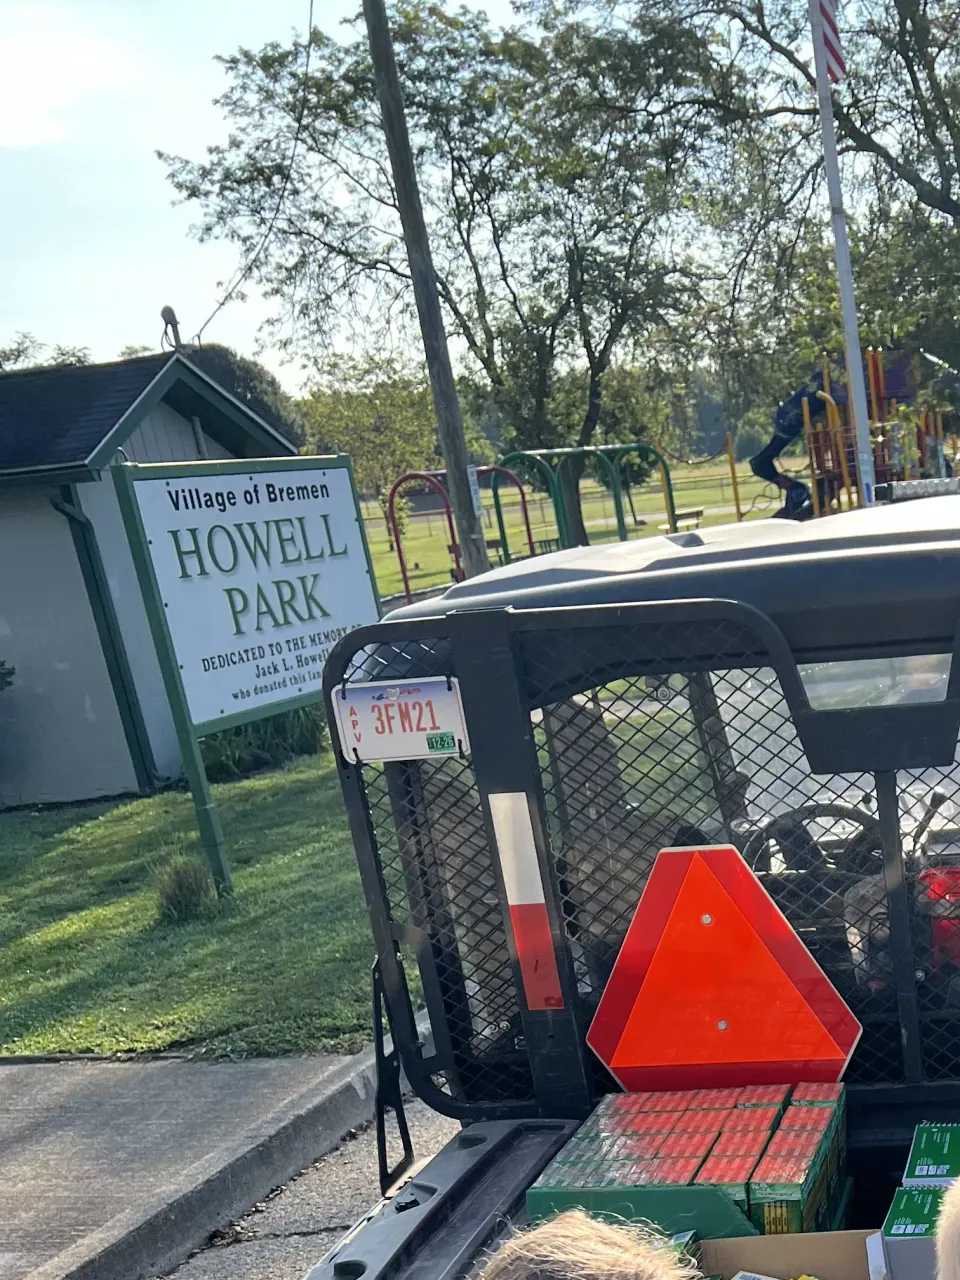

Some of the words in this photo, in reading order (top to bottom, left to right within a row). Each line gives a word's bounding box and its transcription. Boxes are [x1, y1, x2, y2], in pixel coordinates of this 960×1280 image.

[167, 488, 236, 512] Village
[243, 484, 260, 505] of
[266, 483, 330, 503] Bremen
[167, 514, 348, 580] HOWELL
[223, 574, 331, 636] PARK
[202, 647, 266, 673] DEDICATED
[268, 642, 283, 655] TO
[285, 637, 307, 652] THE
[309, 626, 347, 647] MEMORY
[254, 662, 280, 679] Jack
[282, 658, 293, 672] L.
[231, 686, 251, 700] who
[253, 678, 288, 696] donated
[289, 673, 307, 686] this
[371, 700, 441, 735] 3FM21
